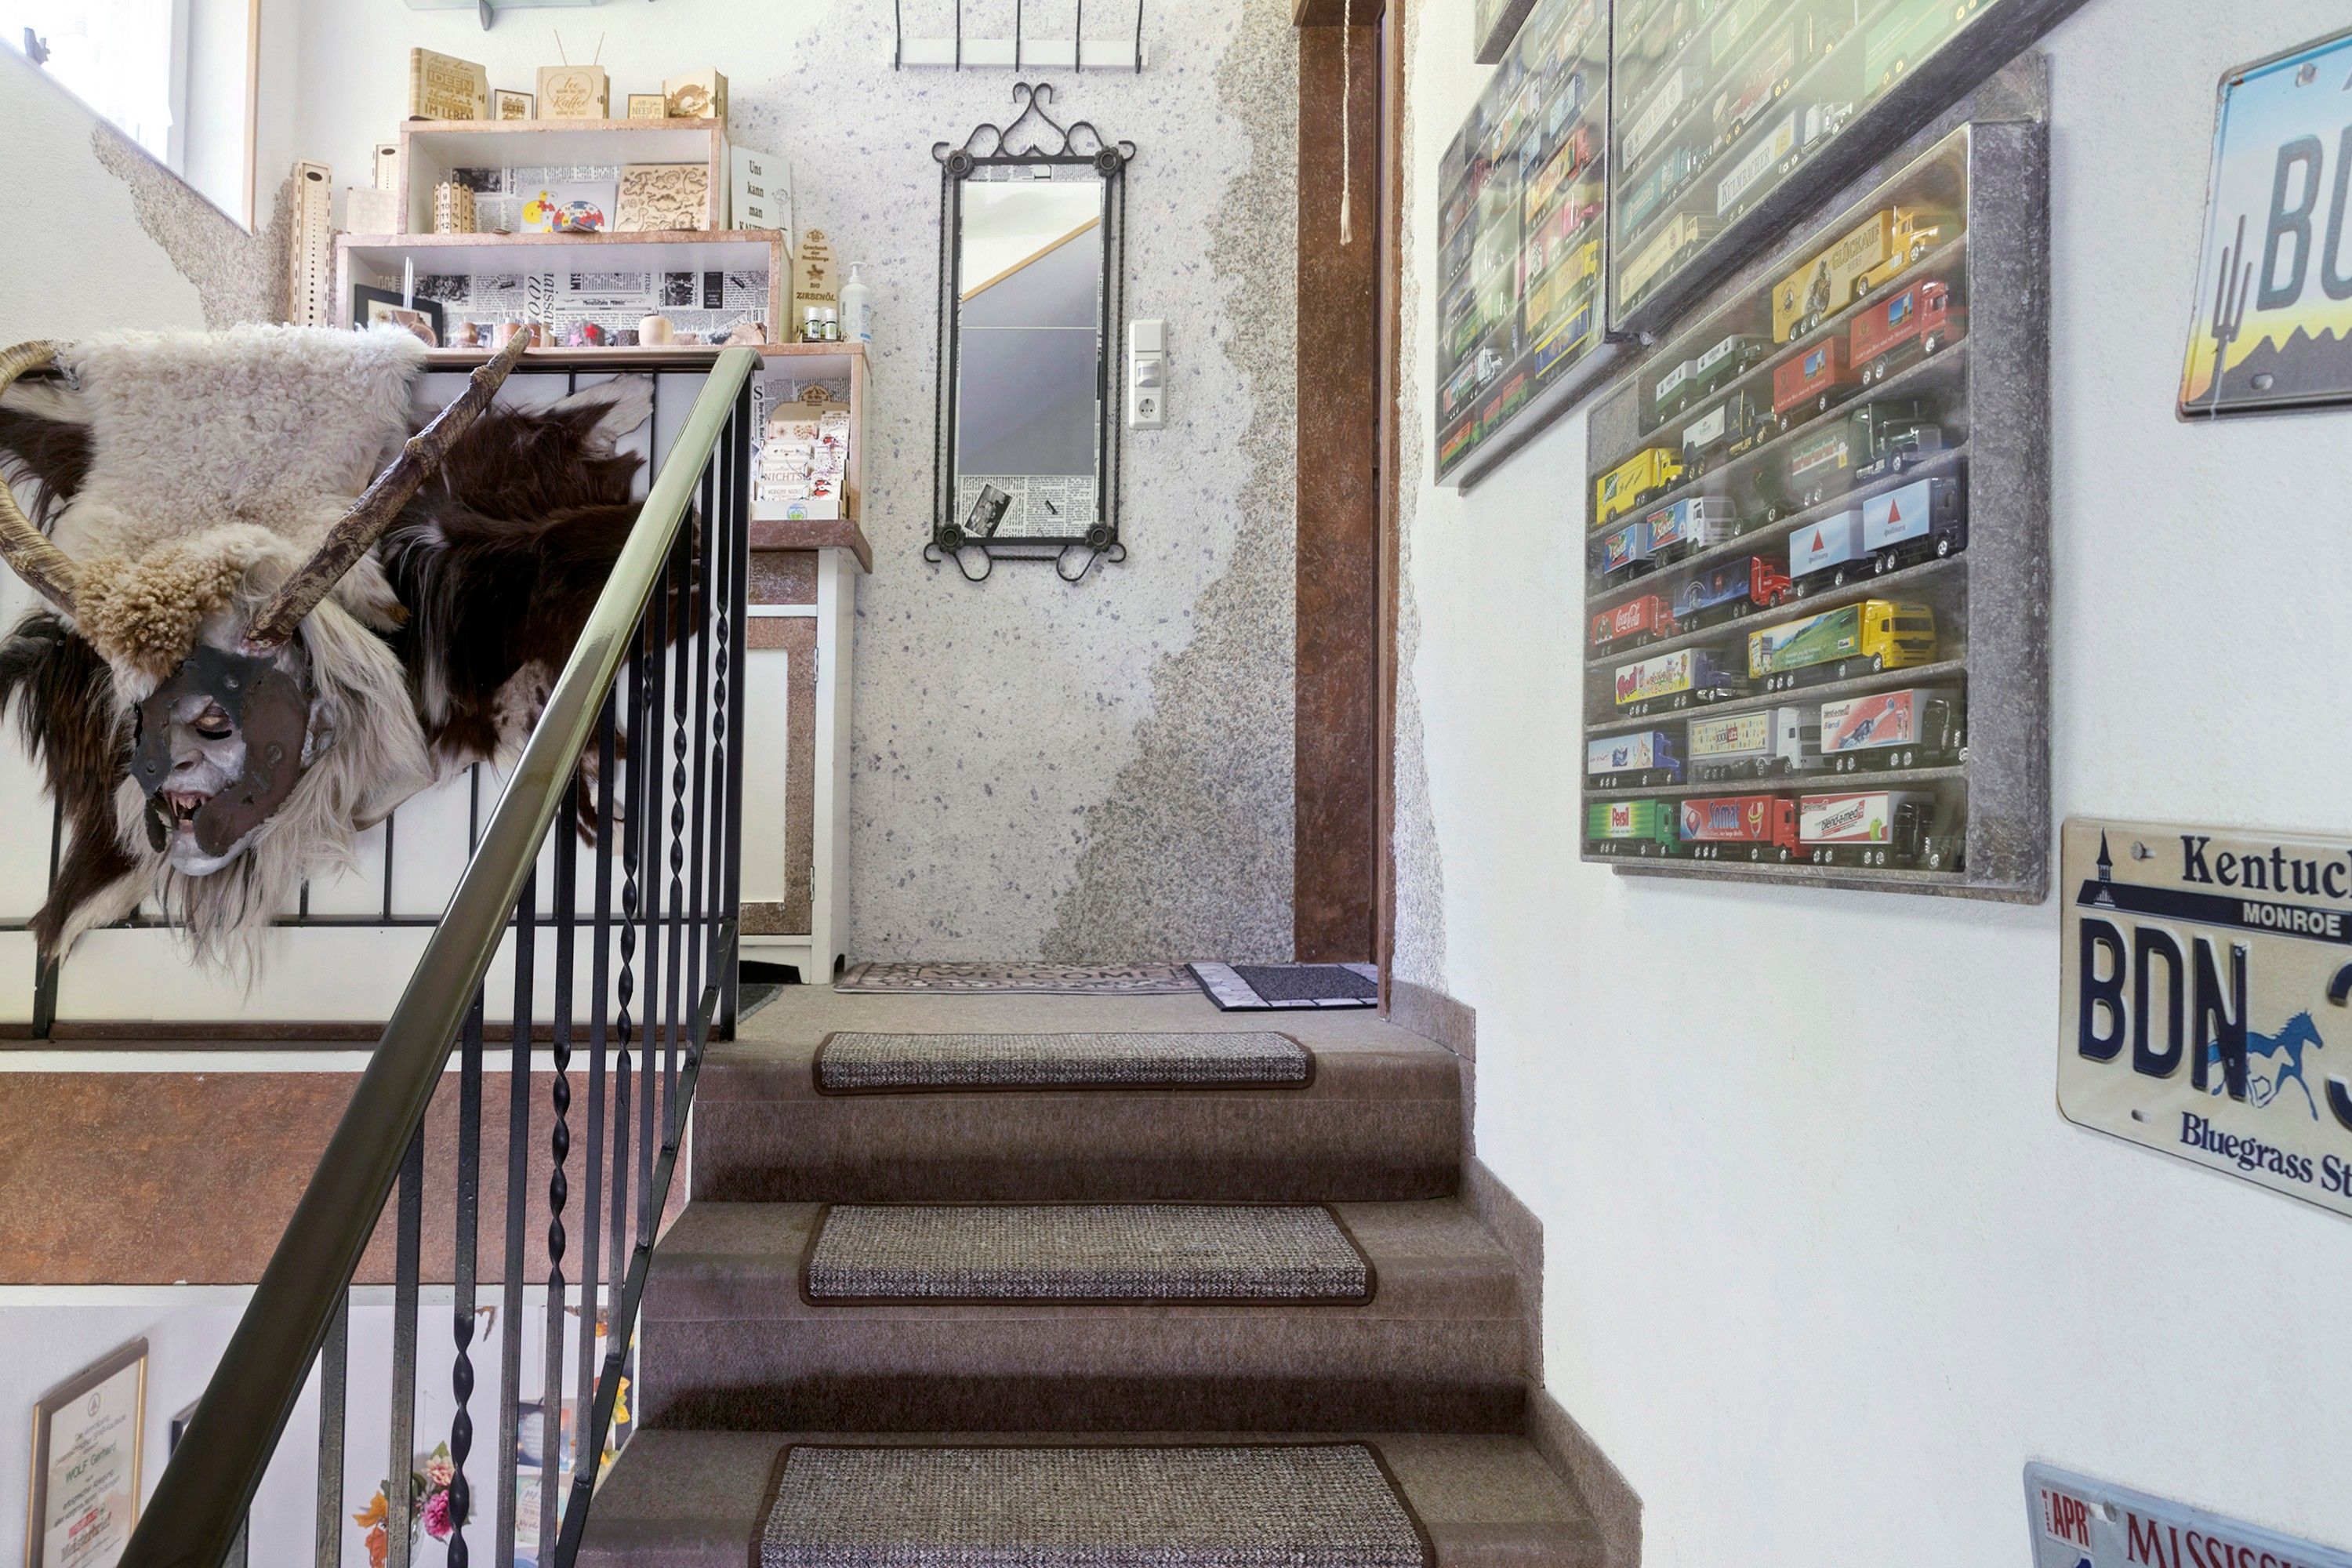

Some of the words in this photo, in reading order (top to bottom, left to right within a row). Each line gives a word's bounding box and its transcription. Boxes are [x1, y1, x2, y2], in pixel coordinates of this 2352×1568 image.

[430, 72, 473, 90] IDEEN
[749, 160, 762, 176] Uns
[747, 181, 764, 198] kann
[749, 205, 763, 217] man
[796, 292, 836, 302] ZIRBENÖL
[764, 472, 803, 481] NICHTS
[1612, 806, 1630, 828] Persil
[1708, 800, 1740, 829] Somat
[1820, 805, 1859, 831] blend-a-med
[2180, 835, 2352, 898] Kentuc
[2242, 901, 2342, 937] MONROE
[2079, 917, 2249, 1102] BDN
[2180, 1111, 2314, 1184] Bluegrass
[65, 1459, 88, 1483] WOLF
[90, 1441, 118, 1466] Gerhard
[2053, 1492, 2090, 1548] APR
[2126, 1512, 2310, 1568] MISSIS
